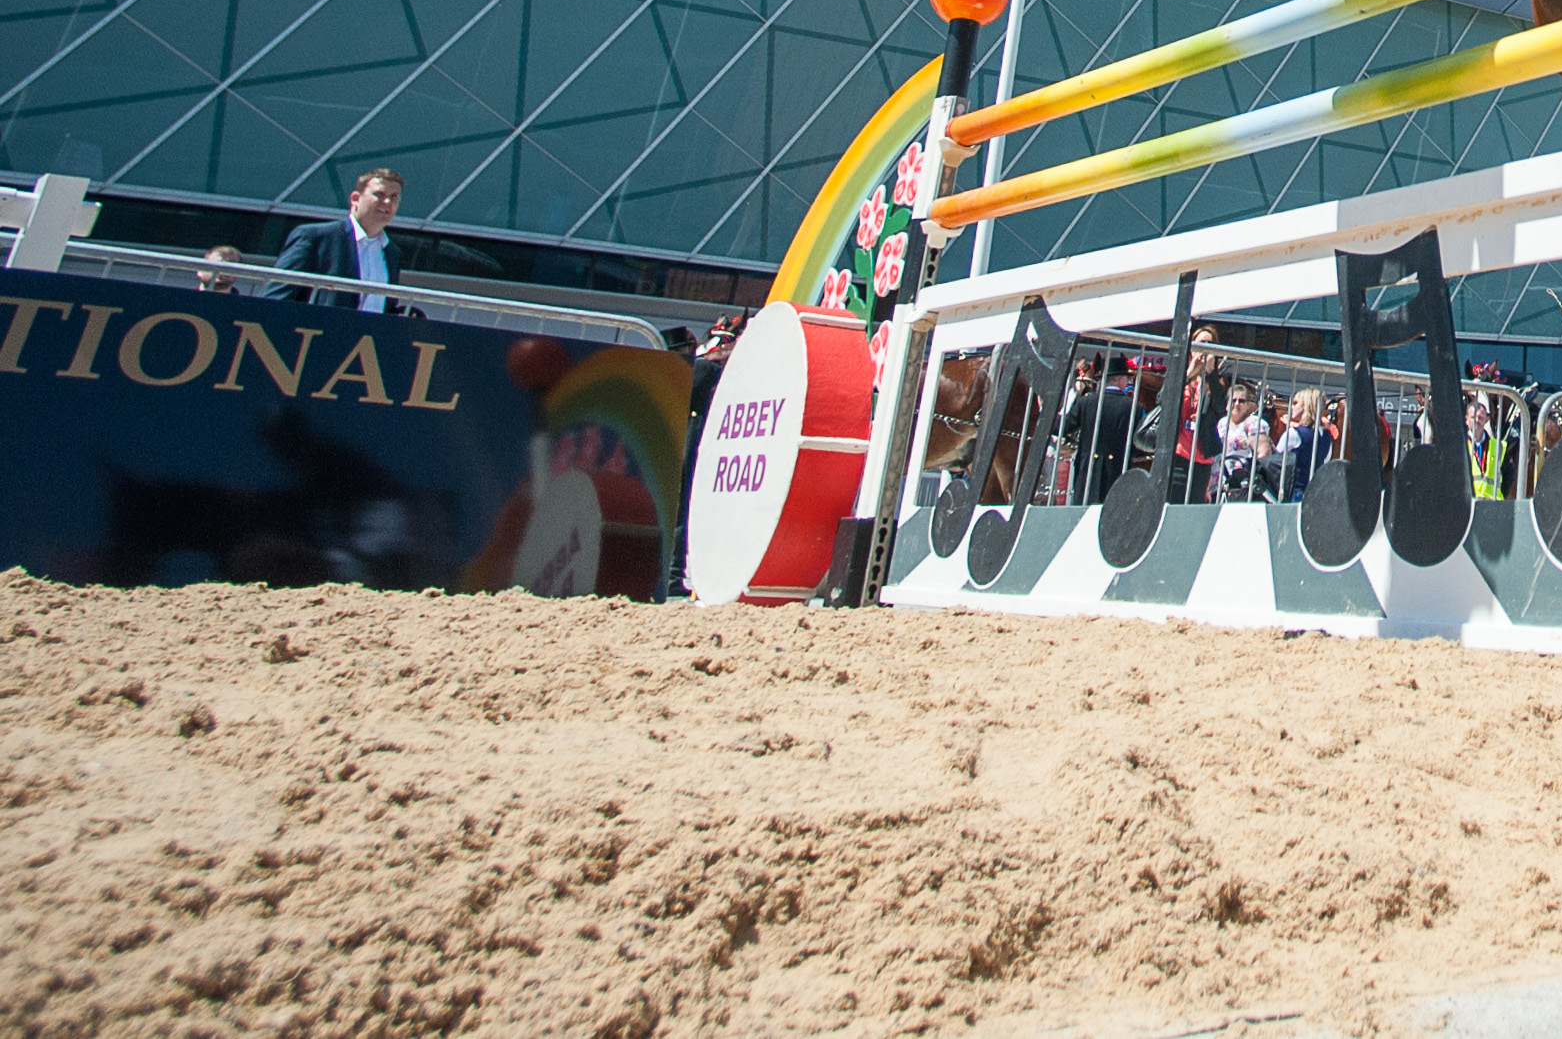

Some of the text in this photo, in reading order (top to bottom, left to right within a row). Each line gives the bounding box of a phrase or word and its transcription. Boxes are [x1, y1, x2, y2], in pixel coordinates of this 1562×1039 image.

[0, 296, 460, 411] TIONAL
[713, 398, 786, 492] ABBEY ROAD
